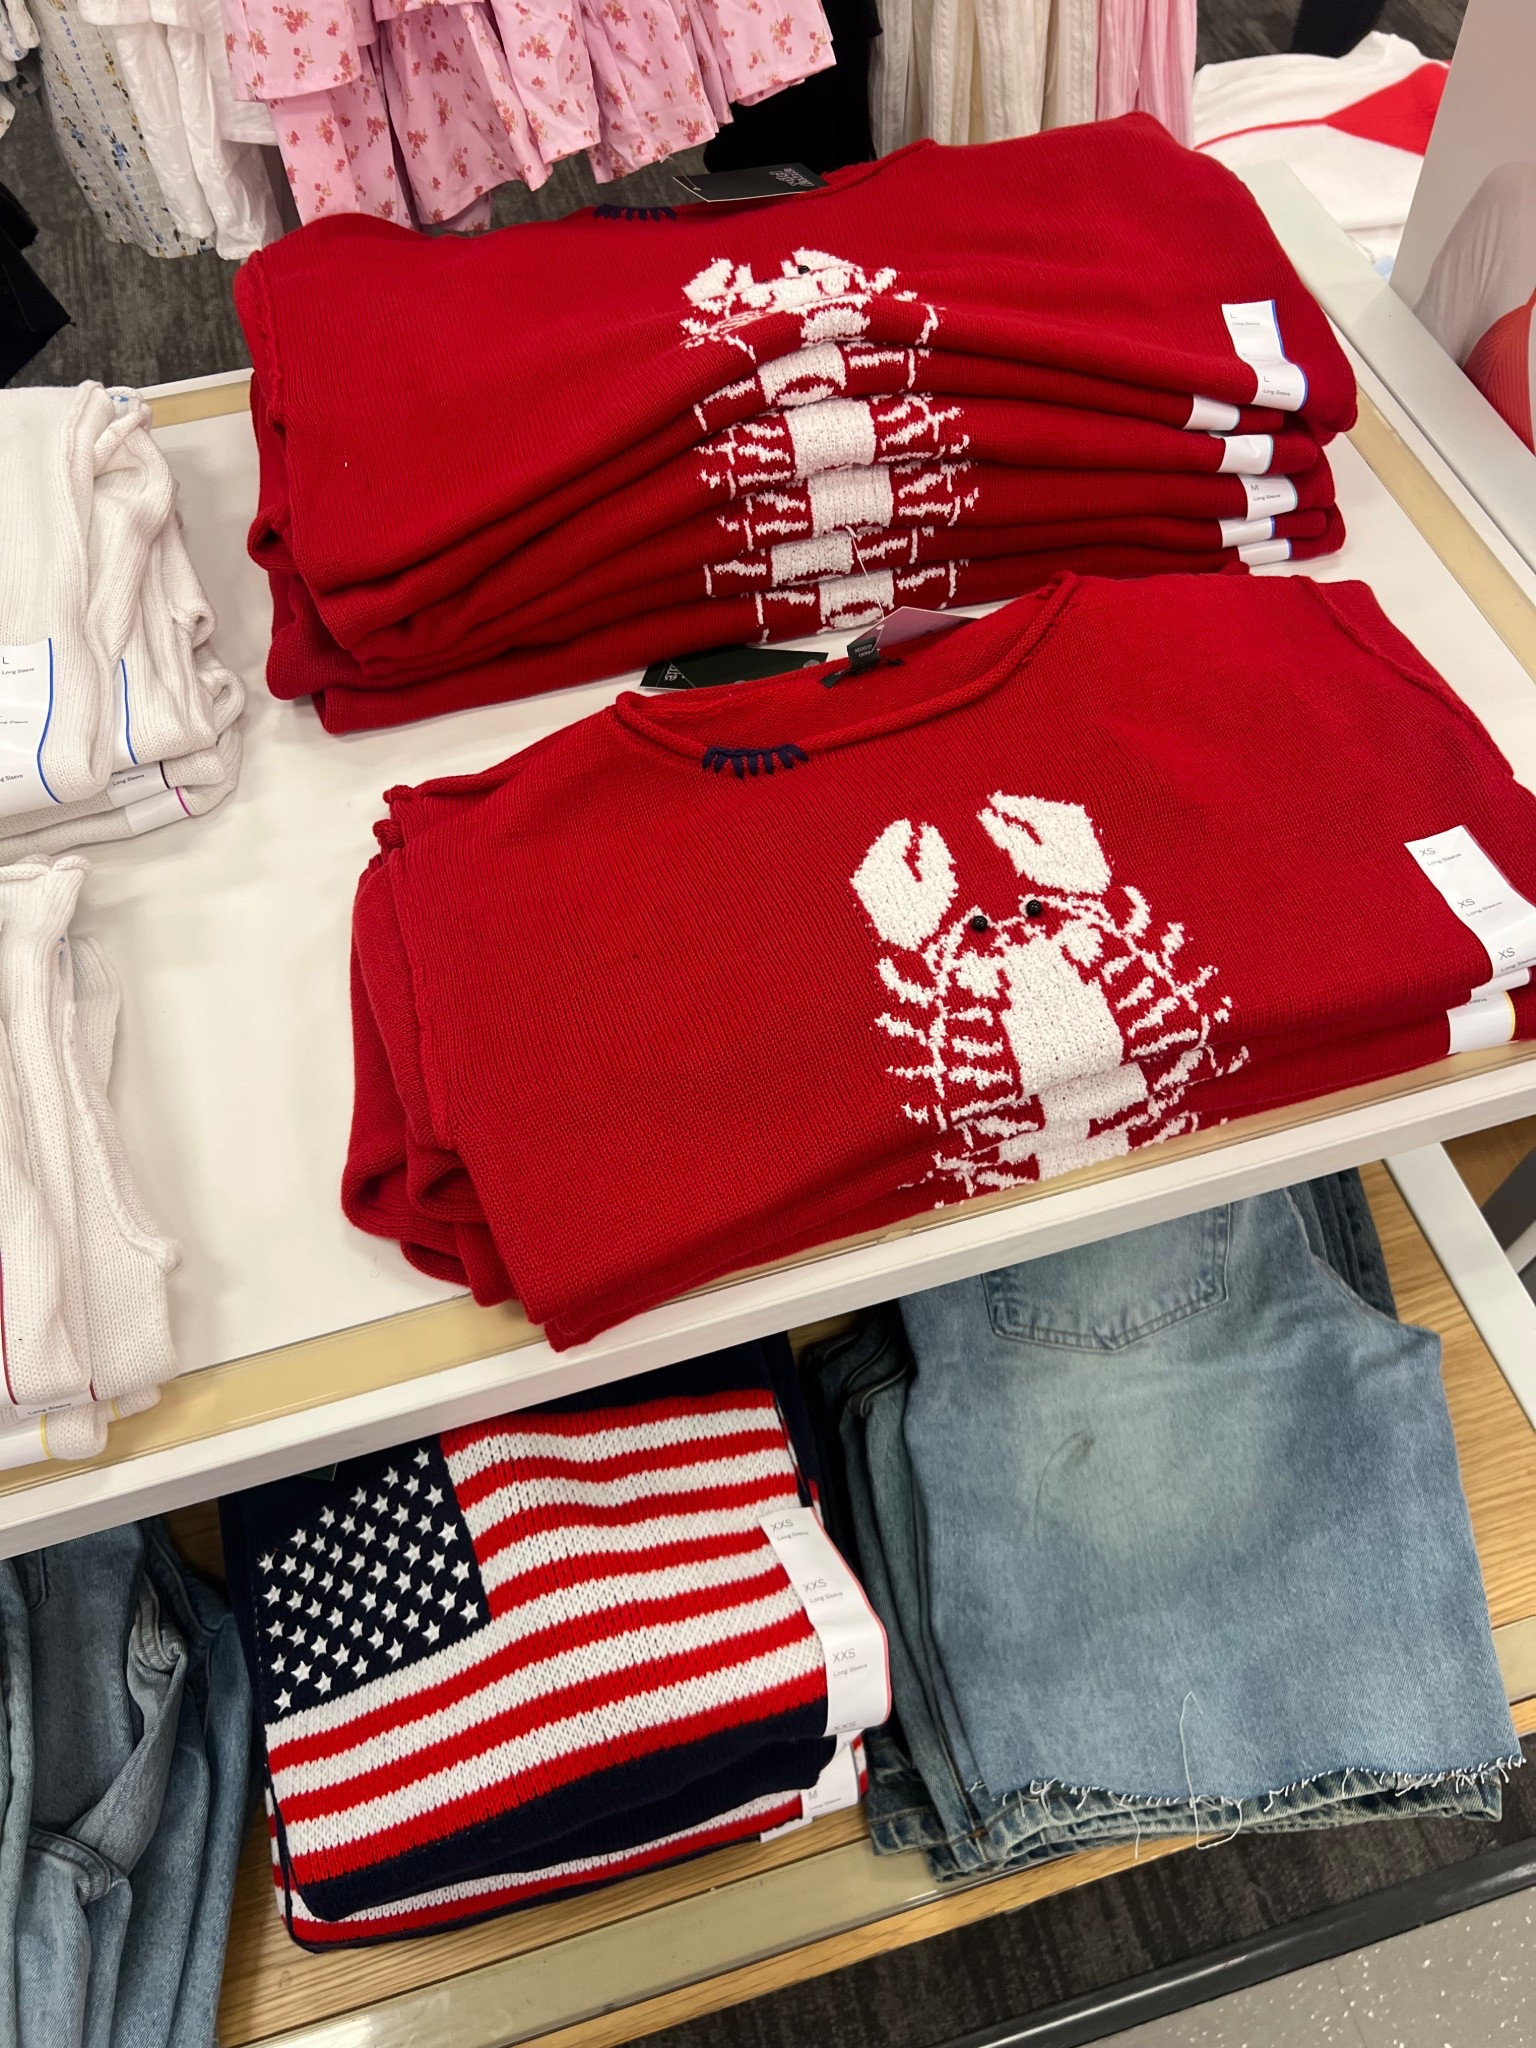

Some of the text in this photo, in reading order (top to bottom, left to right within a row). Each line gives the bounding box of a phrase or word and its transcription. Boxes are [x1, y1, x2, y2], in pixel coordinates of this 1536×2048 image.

[2, 656, 10, 664] L
[5, 773, 24, 781] Sleeve
[1419, 847, 1436, 857] XS
[1457, 898, 1476, 908] XS
[1498, 947, 1515, 960] XS
[770, 1519, 794, 1532] XXS
[802, 1578, 827, 1592] XXS
[832, 1647, 856, 1664] XXS
